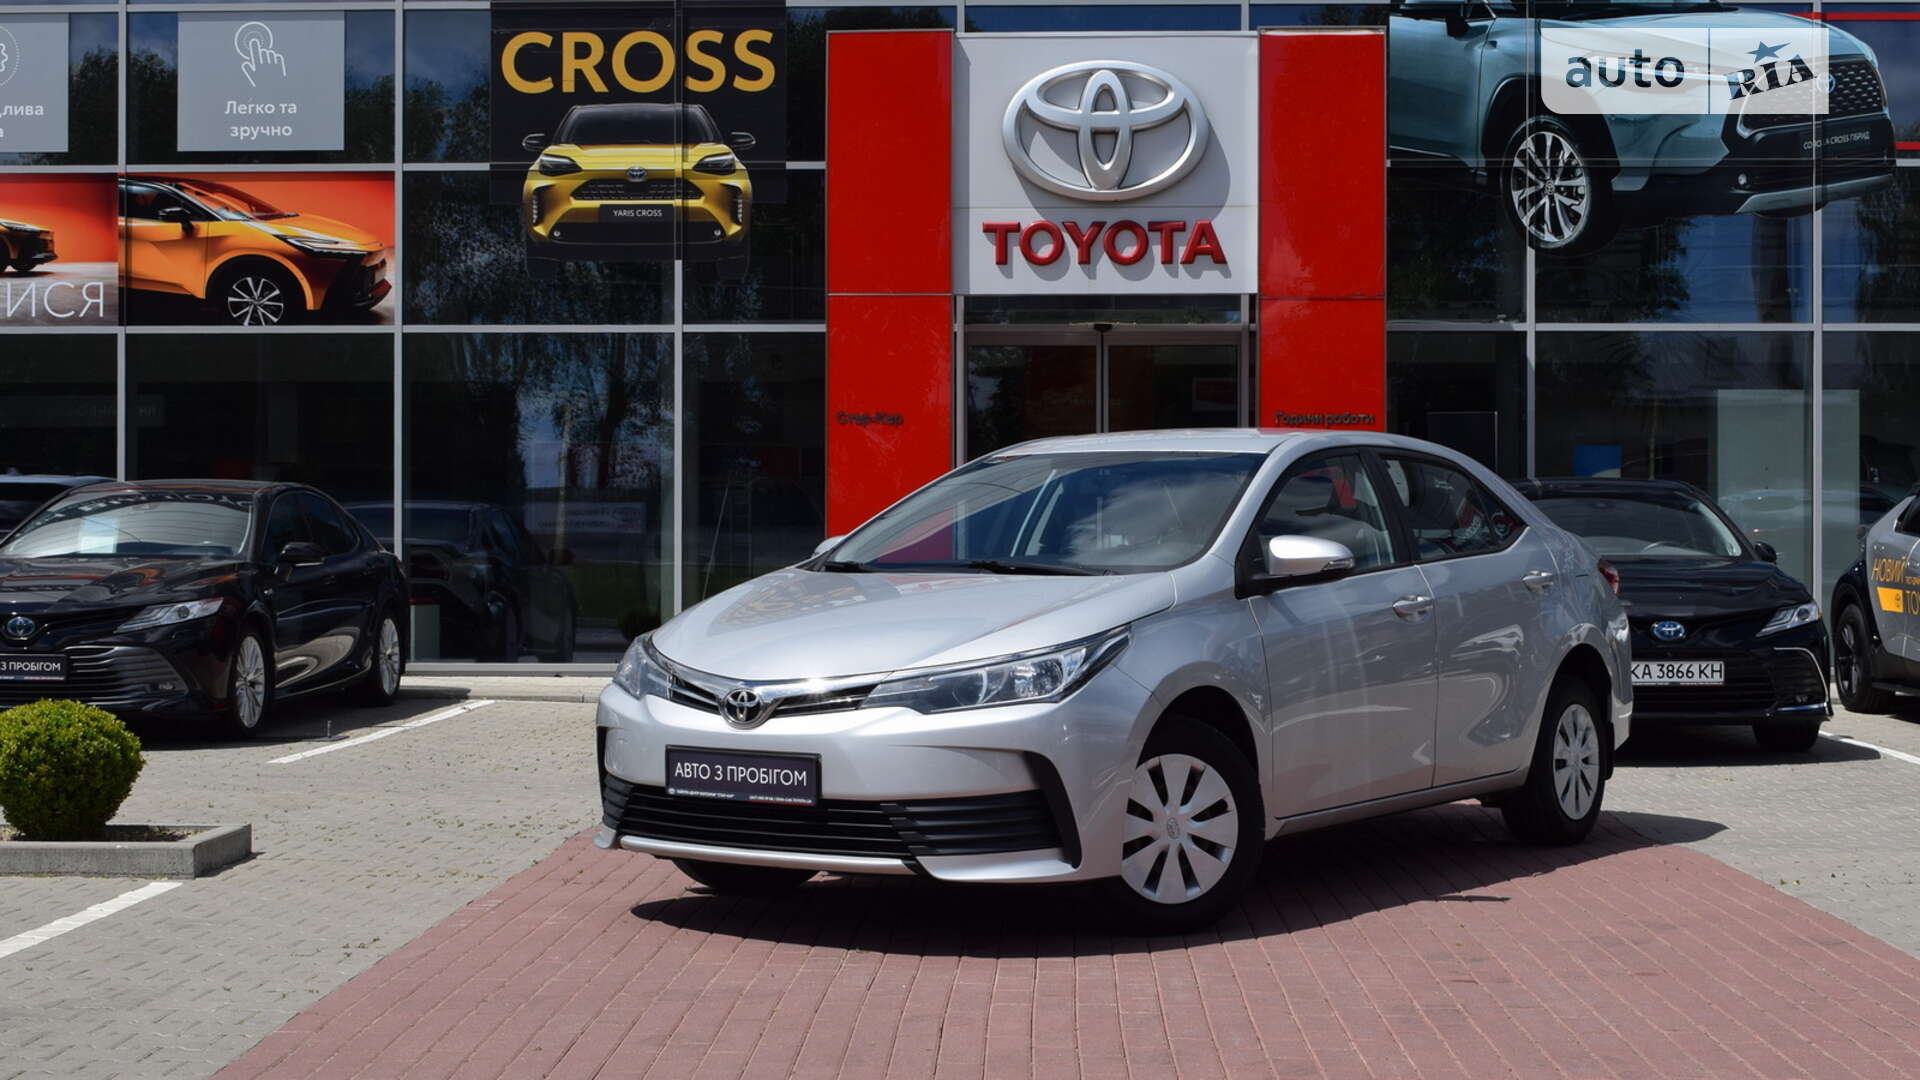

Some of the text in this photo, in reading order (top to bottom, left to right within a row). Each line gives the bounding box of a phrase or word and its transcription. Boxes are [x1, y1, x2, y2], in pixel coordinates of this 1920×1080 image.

[501, 29, 776, 94] CROSS
[0, 104, 45, 118] лива
[224, 100, 297, 115] Легко та
[230, 126, 293, 140] зручно
[612, 209, 663, 217] YARIS CROSS
[982, 219, 1228, 266] TOYOTA
[7, 282, 104, 318] ИСЯ
[1905, 590, 1920, 616] TO
[9, 661, 61, 671] ПРОБІГОМ
[1631, 663, 1723, 679] KA 3866 KH
[674, 761, 807, 787] АВТО З ПРОБІГОМ
